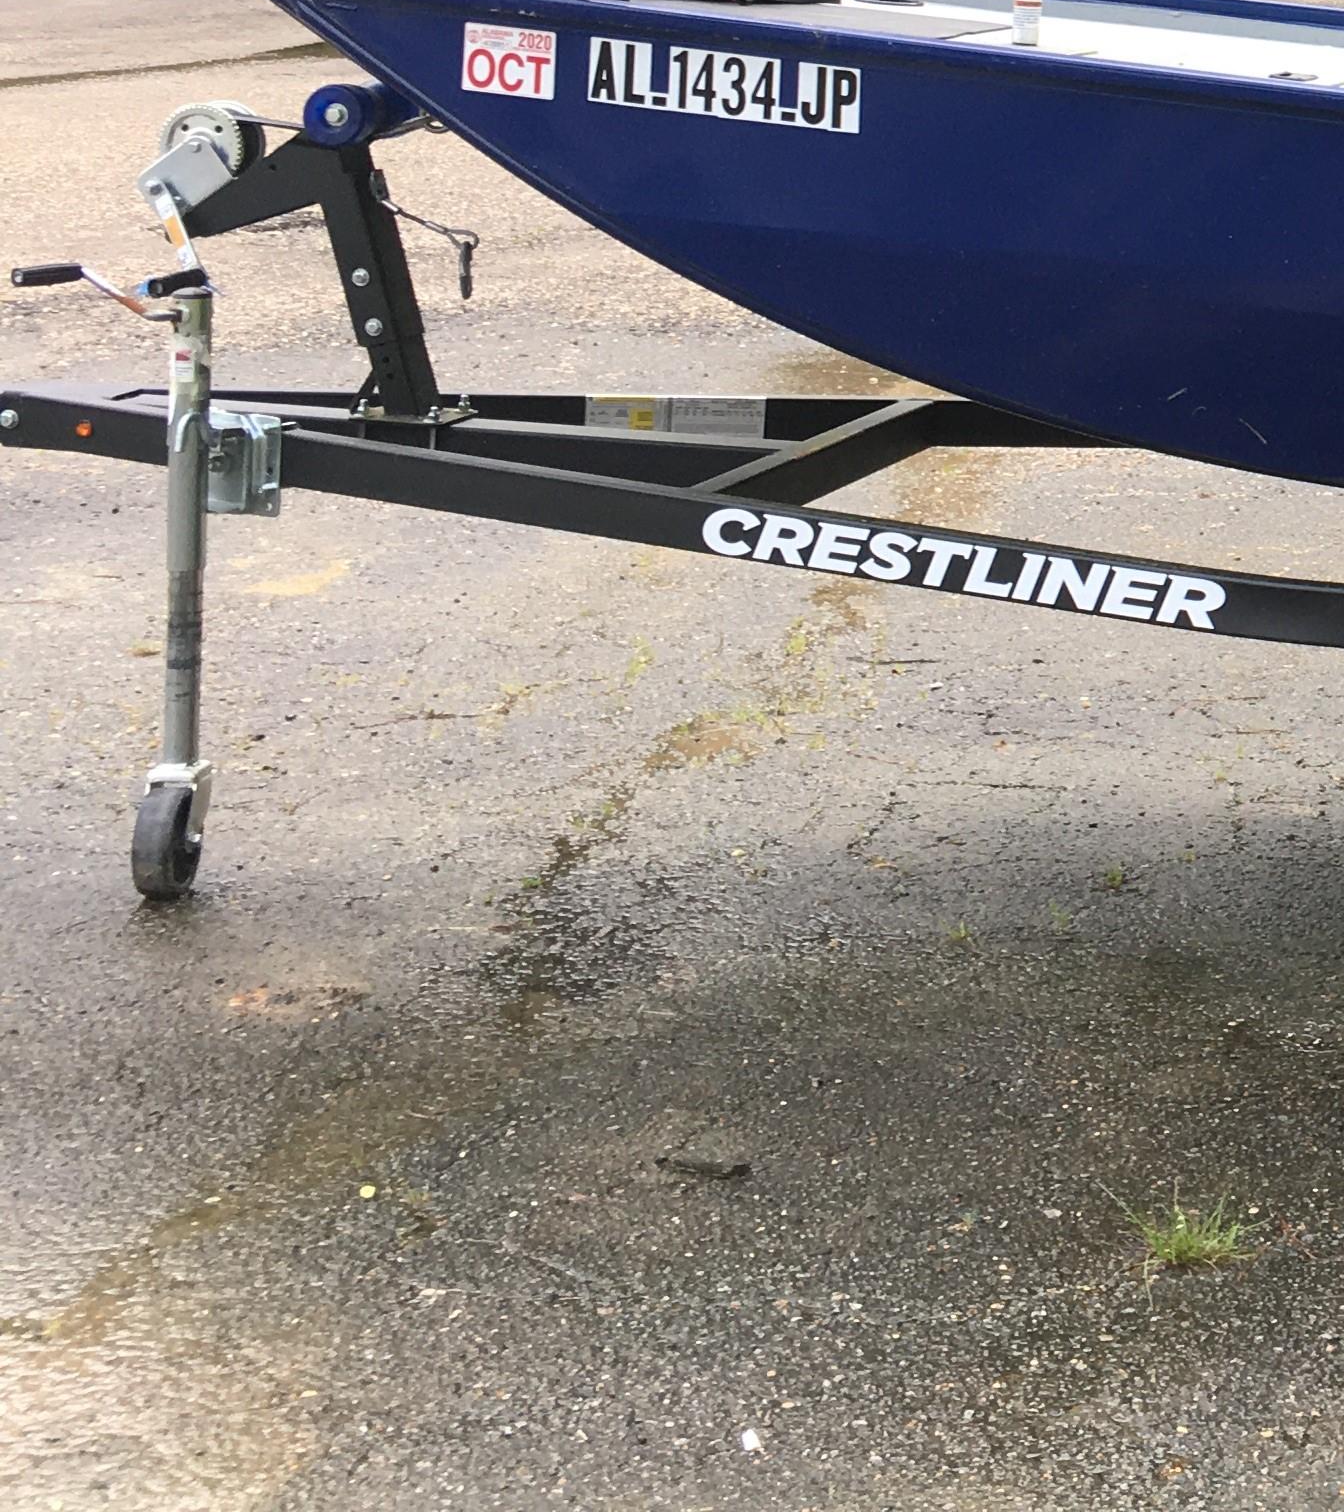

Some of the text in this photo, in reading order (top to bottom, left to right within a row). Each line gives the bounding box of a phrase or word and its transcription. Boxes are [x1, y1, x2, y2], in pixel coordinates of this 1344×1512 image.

[518, 31, 553, 51] 2020
[467, 48, 551, 94] OCT
[701, 507, 1228, 630] CRESTLINER
